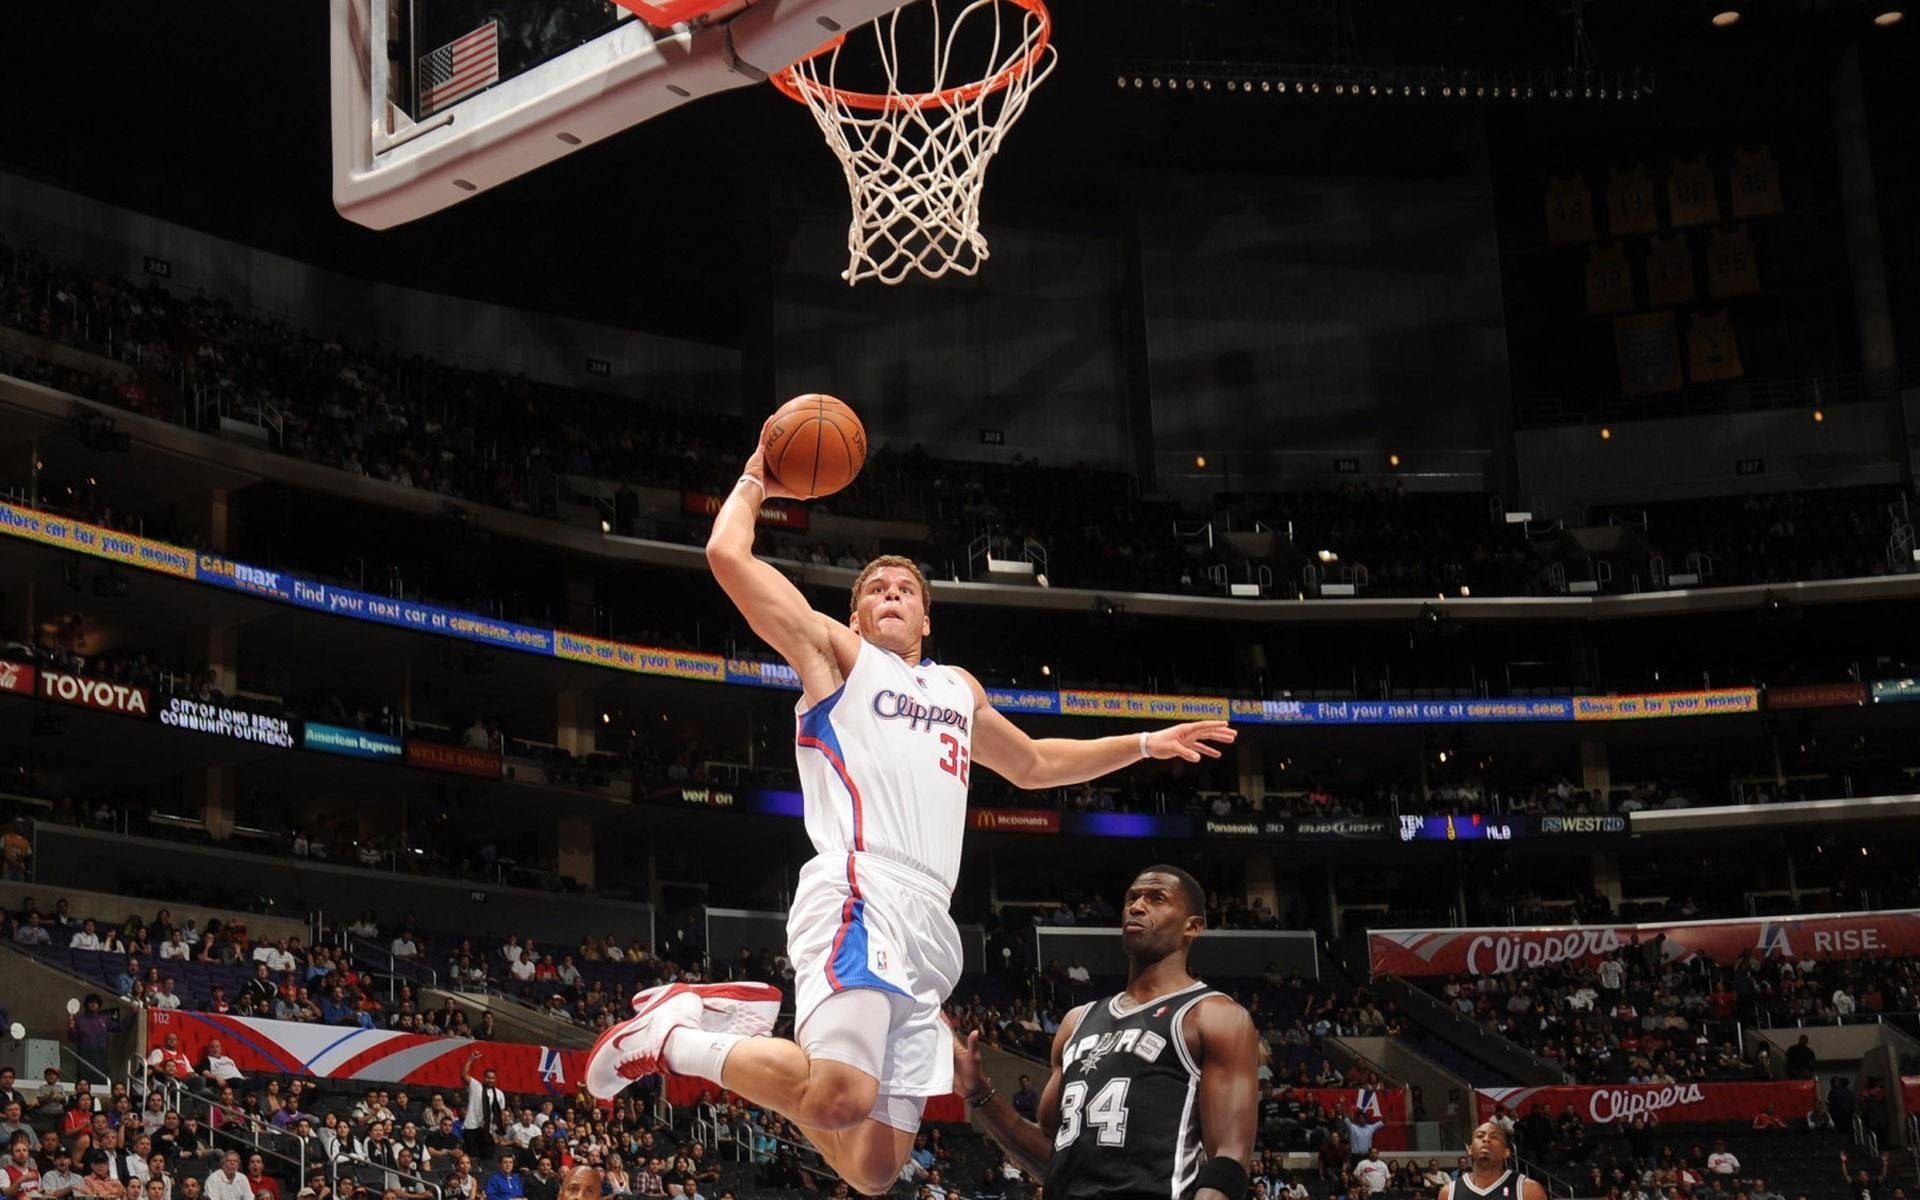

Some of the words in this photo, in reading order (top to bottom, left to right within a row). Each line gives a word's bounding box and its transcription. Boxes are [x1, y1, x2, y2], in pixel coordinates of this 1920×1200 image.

[102, 533, 136, 555] your
[293, 581, 325, 602] Find
[329, 593, 364, 610] your
[368, 601, 400, 616] next
[404, 608, 427, 622] car
[431, 613, 447, 627] at
[41, 671, 147, 714] TOYOTA
[160, 708, 235, 737] COMMUNITY
[170, 698, 199, 716] CITY
[218, 706, 248, 725] LONG
[1318, 702, 1348, 719] Find
[1352, 705, 1383, 721] your
[1389, 703, 1418, 718] next
[1423, 704, 1444, 717] car
[306, 729, 358, 748] American
[359, 736, 402, 755] Express
[998, 815, 1048, 827] McDonald's
[1207, 821, 1259, 834] Panasonic
[1814, 928, 1886, 952] RISE.
[153, 1012, 170, 1025] 102
[538, 1045, 566, 1084] LA
[1055, 1077, 1131, 1150] 34
[1590, 1082, 1705, 1123] Clippers
